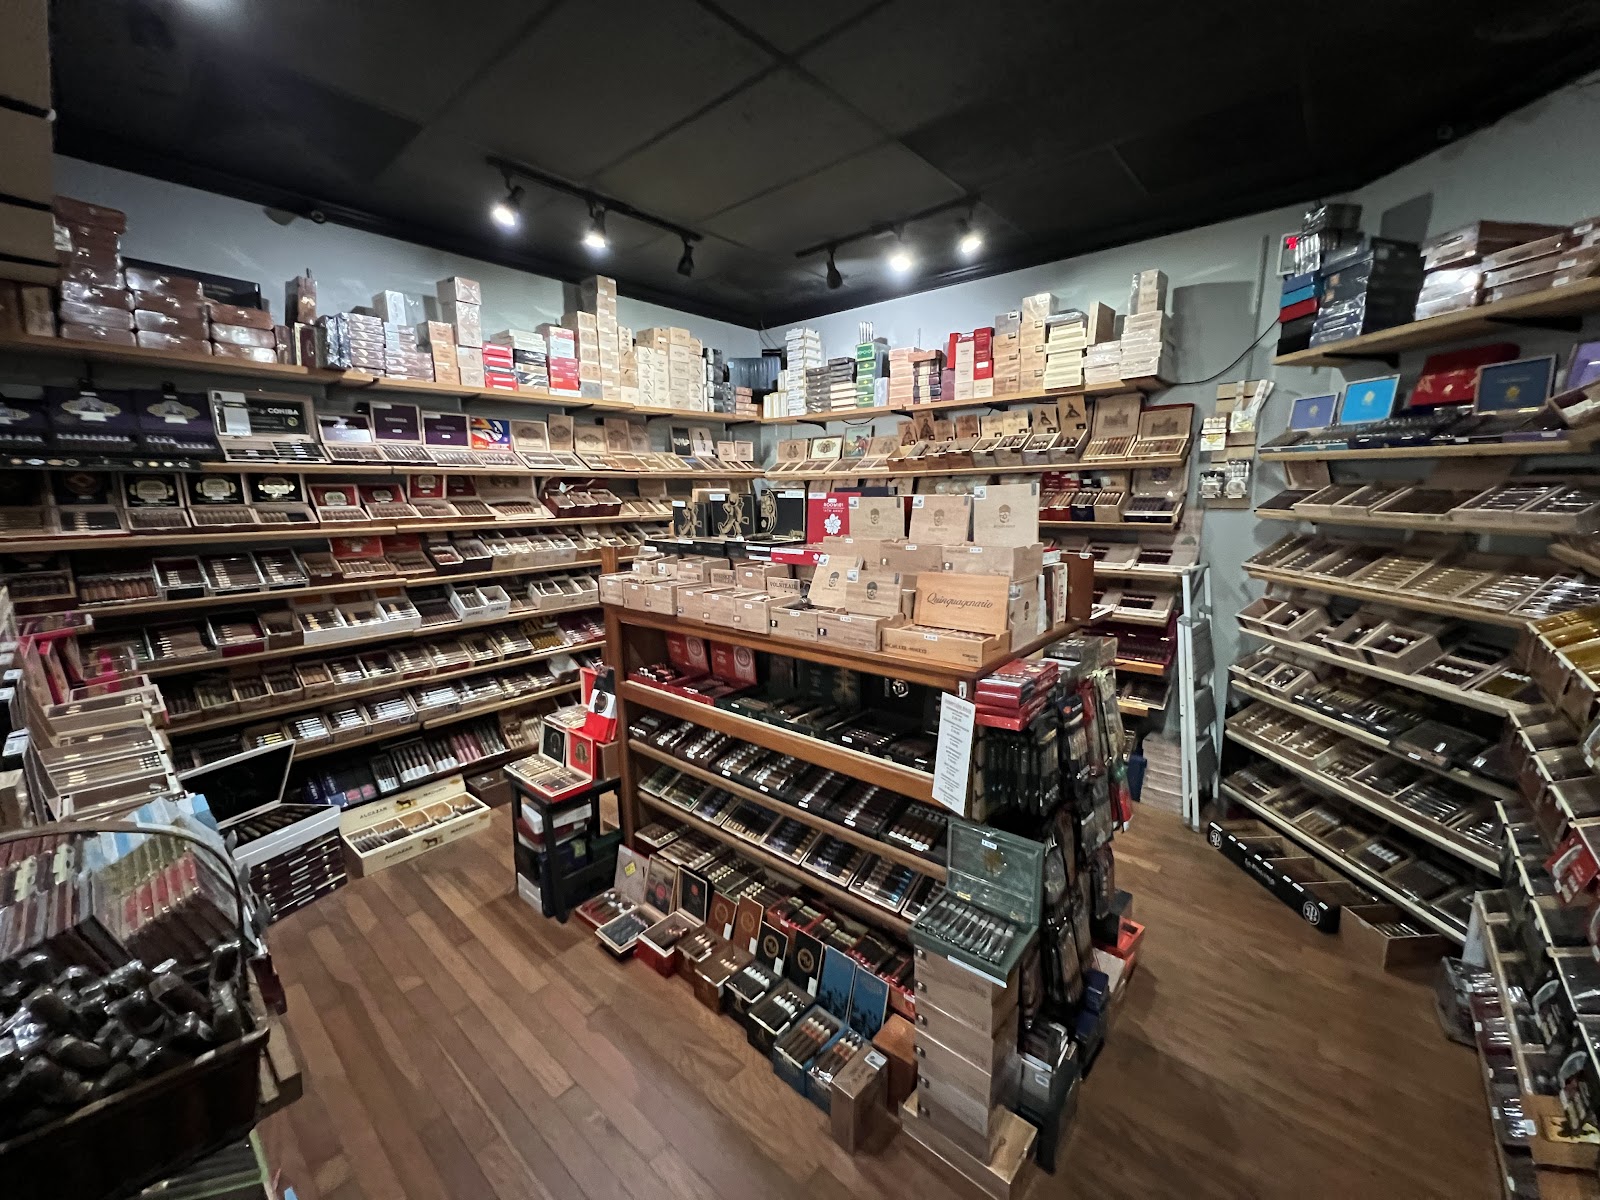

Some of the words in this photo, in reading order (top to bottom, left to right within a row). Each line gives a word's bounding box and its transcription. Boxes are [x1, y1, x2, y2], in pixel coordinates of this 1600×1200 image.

[267, 407, 299, 416] COHIBA
[926, 592, 994, 609] Quinquagenario
[359, 806, 388, 819] ALCAZAR
[384, 845, 413, 860] ALCAZAR
